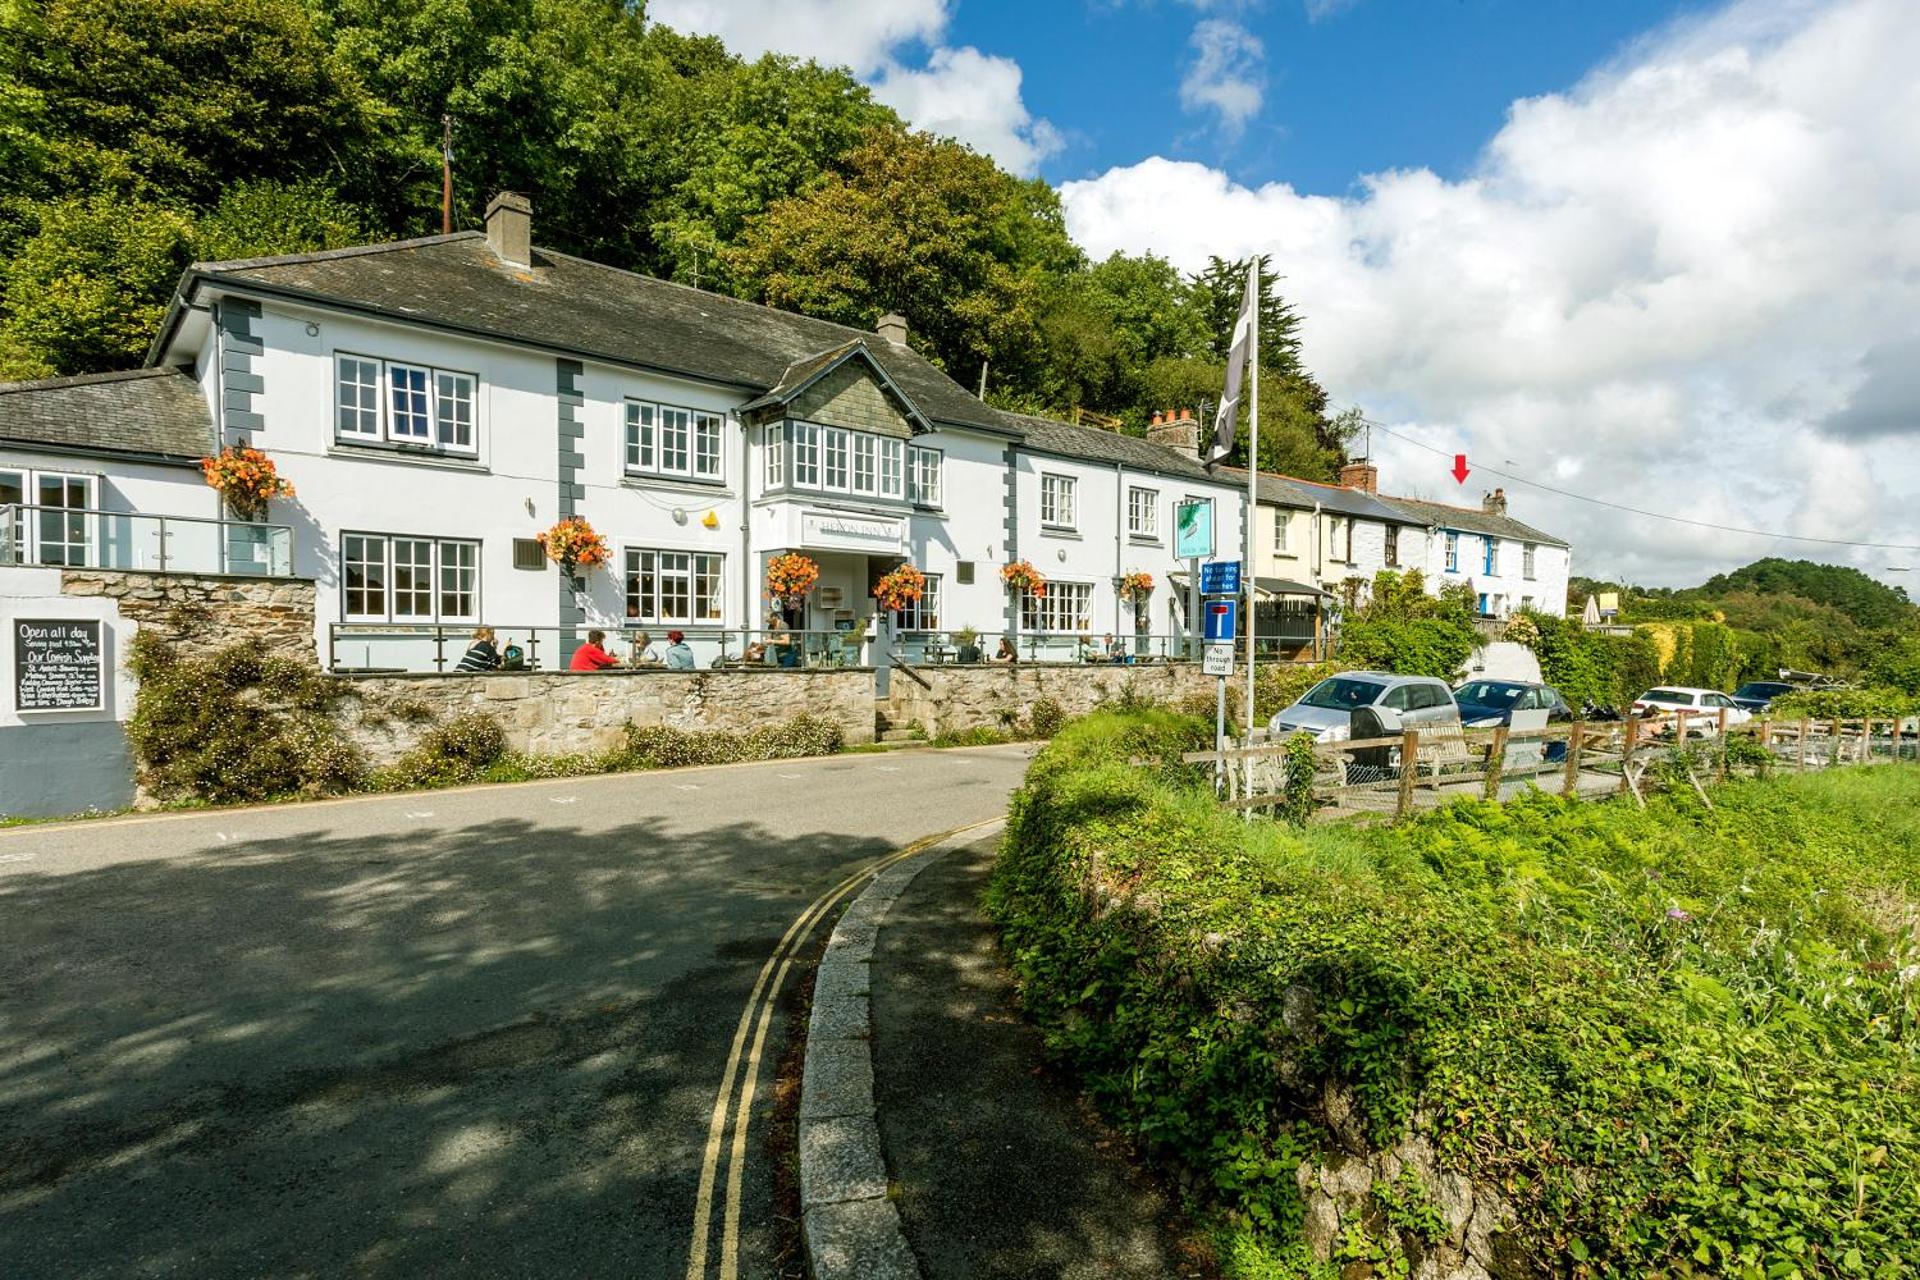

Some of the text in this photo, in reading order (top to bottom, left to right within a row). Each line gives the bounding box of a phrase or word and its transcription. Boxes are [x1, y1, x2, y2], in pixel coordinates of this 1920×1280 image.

[1204, 566, 1213, 574] No
[1225, 573, 1236, 581] for
[20, 624, 88, 641] Open all day
[27, 650, 45, 663] Our
[46, 649, 73, 663] Cornish
[1206, 655, 1231, 664] through
